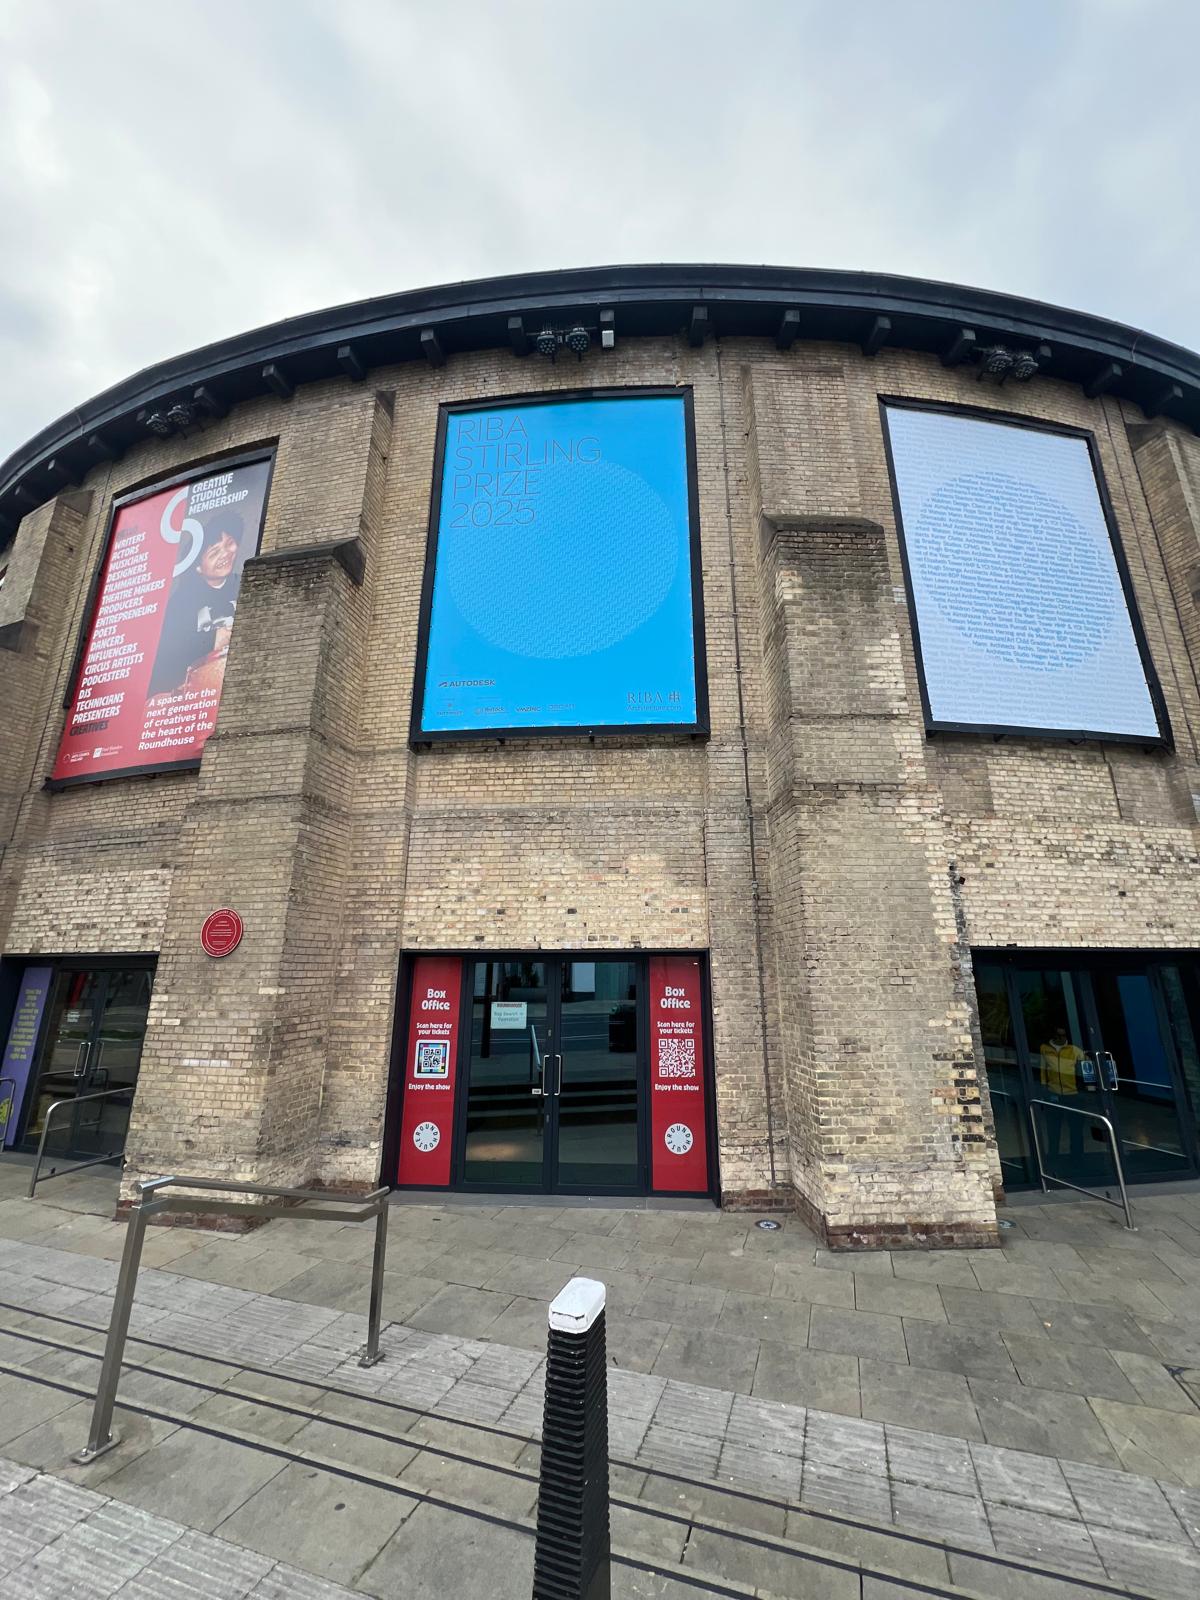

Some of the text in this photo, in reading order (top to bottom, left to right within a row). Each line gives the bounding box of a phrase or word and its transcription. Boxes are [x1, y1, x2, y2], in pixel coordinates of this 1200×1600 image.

[458, 415, 528, 443] RIBA
[454, 436, 601, 471] STIRLING
[192, 472, 234, 494] CREATIVE
[453, 469, 543, 500] PRIZE
[188, 489, 249, 516] MEMBERSHIP
[190, 485, 228, 505] STUDIOS
[450, 498, 535, 528] 2025
[115, 531, 146, 550] WRITERS
[109, 552, 149, 573] MUSICIANS
[112, 544, 140, 561] ACTORS
[106, 562, 147, 584] DESIGNERS
[102, 579, 166, 606] THEATRE MAKERS
[103, 572, 152, 595] FILMMAKERS
[95, 602, 158, 629] ENTREPRENEURS
[98, 596, 144, 617] PRODUCERS
[90, 634, 125, 652] DANCERS
[93, 625, 117, 641] POETS
[87, 643, 138, 663] INFLUENCERS
[84, 652, 145, 676] CIRCUS ARTISTS
[81, 667, 131, 688] PODCASTERS
[449, 679, 496, 687] AUTODESK
[76, 692, 125, 712] TECHNICIANS
[148, 687, 217, 708] A space for the
[627, 691, 663, 704] RIBA
[72, 705, 121, 725] PRESENTERS
[147, 698, 218, 718] next generation
[143, 710, 208, 729] of creatives in
[141, 720, 214, 740] the heart of the
[138, 736, 195, 751] Roundhouse
[427, 988, 446, 999] Box
[665, 986, 685, 997] Box
[421, 1000, 450, 1010] Office
[660, 998, 691, 1009] Office
[408, 1083, 424, 1091] Enjoy
[654, 1083, 671, 1091] Enjoy
[415, 1123, 438, 1150] ROUNDHOUSE
[666, 1125, 691, 1152] ROUNDHOUSE
